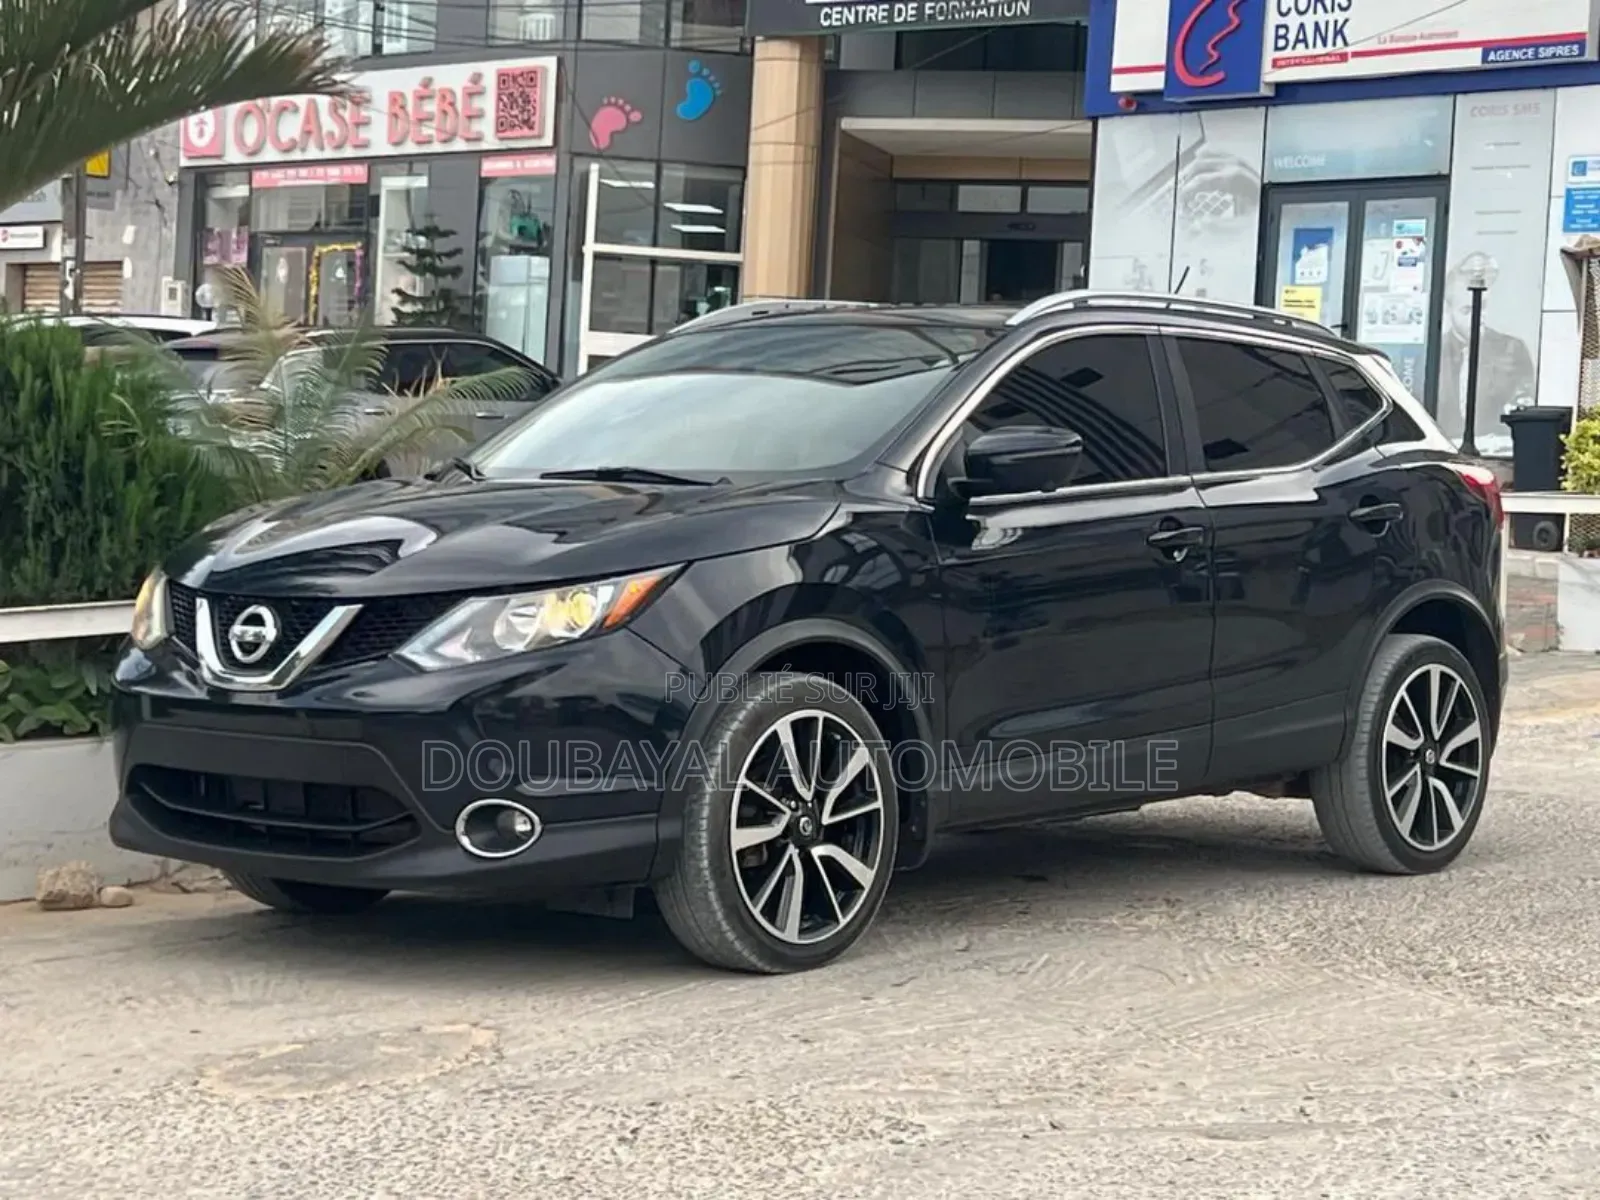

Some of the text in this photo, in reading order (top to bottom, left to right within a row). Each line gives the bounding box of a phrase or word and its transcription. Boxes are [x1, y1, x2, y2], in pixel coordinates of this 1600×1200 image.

[820, 0, 1031, 27] CENTRE DE FORMATION
[1273, 18, 1350, 52] BANK
[1487, 44, 1580, 62] AGENCE SIPRES
[387, 72, 484, 146] BÉBÉ
[1274, 154, 1326, 169] WELCOME
